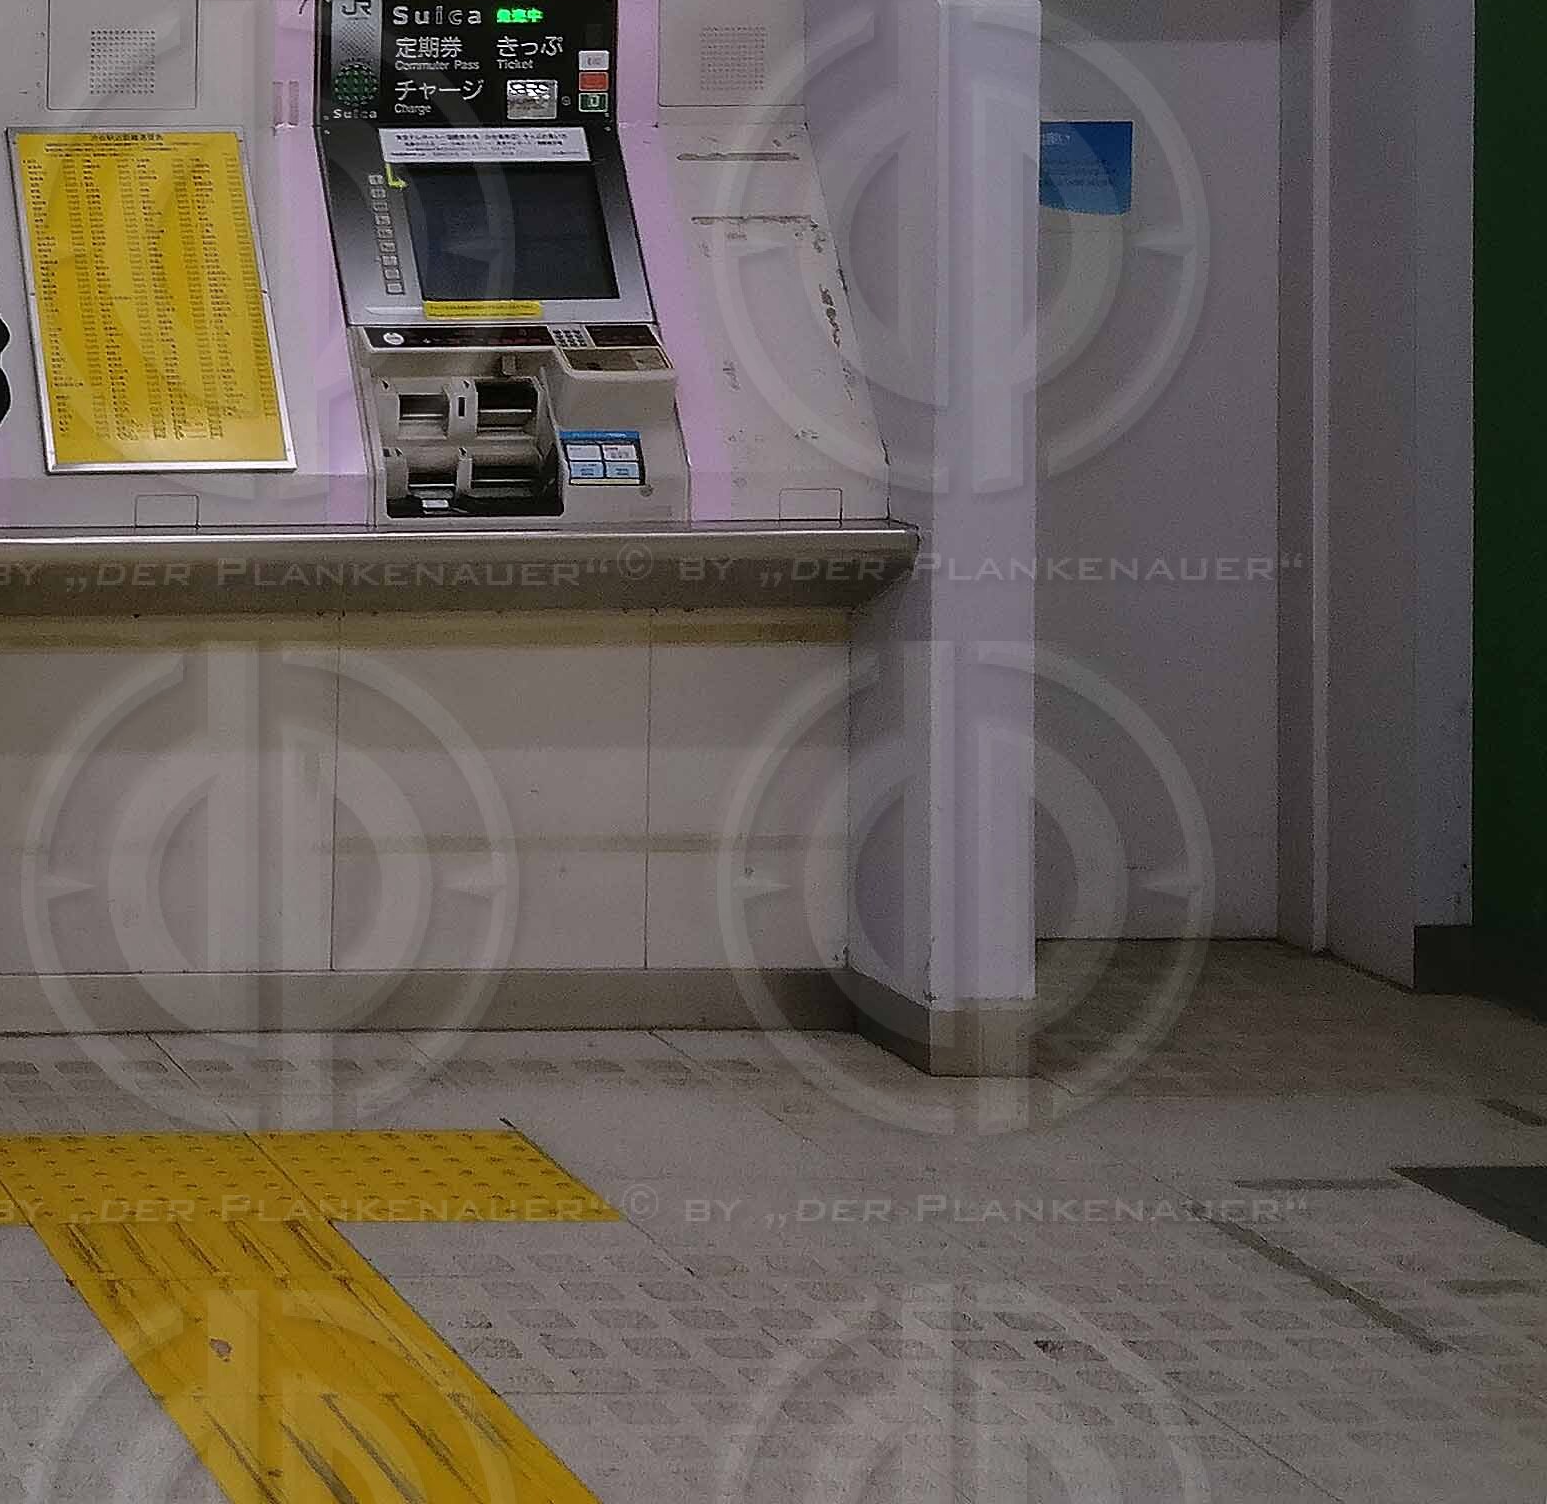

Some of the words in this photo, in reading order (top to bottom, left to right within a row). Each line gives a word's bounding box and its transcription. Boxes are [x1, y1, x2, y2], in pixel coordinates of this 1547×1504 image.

[392, 6, 482, 26] Suica
[395, 37, 463, 59] 定期券
[497, 36, 564, 57] きっぷ
[395, 79, 484, 101] チャージ
[394, 103, 432, 114] Charge
